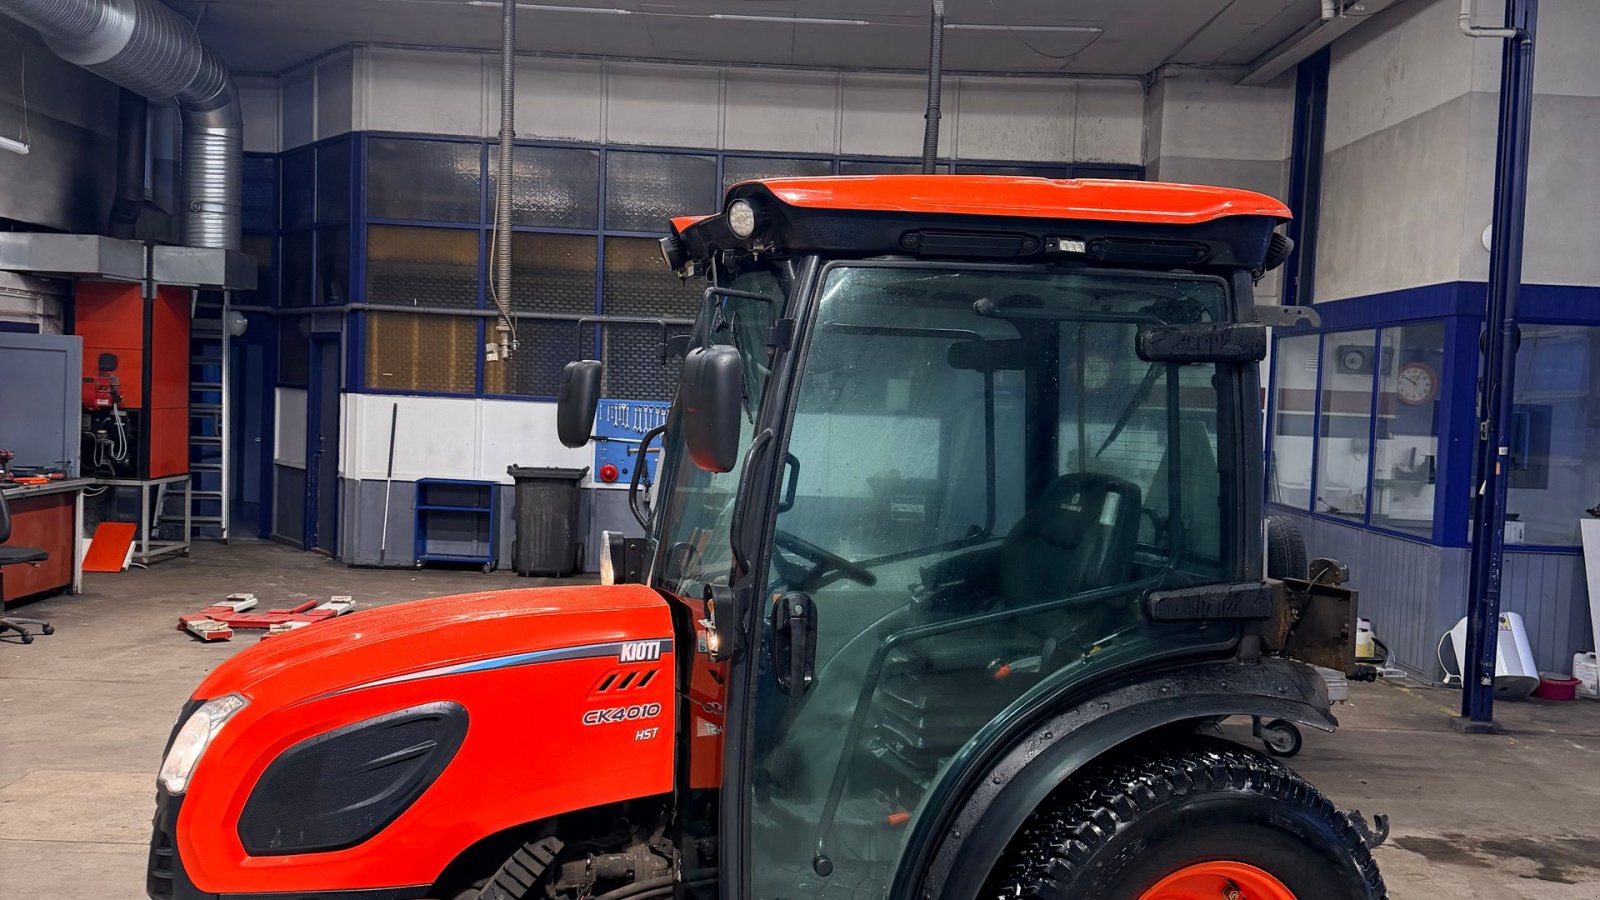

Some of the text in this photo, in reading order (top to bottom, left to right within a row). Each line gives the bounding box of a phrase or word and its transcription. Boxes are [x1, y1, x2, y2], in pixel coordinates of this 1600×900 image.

[620, 641, 661, 662] KIOTI
[583, 703, 662, 725] CK4010
[634, 727, 660, 741] HST
